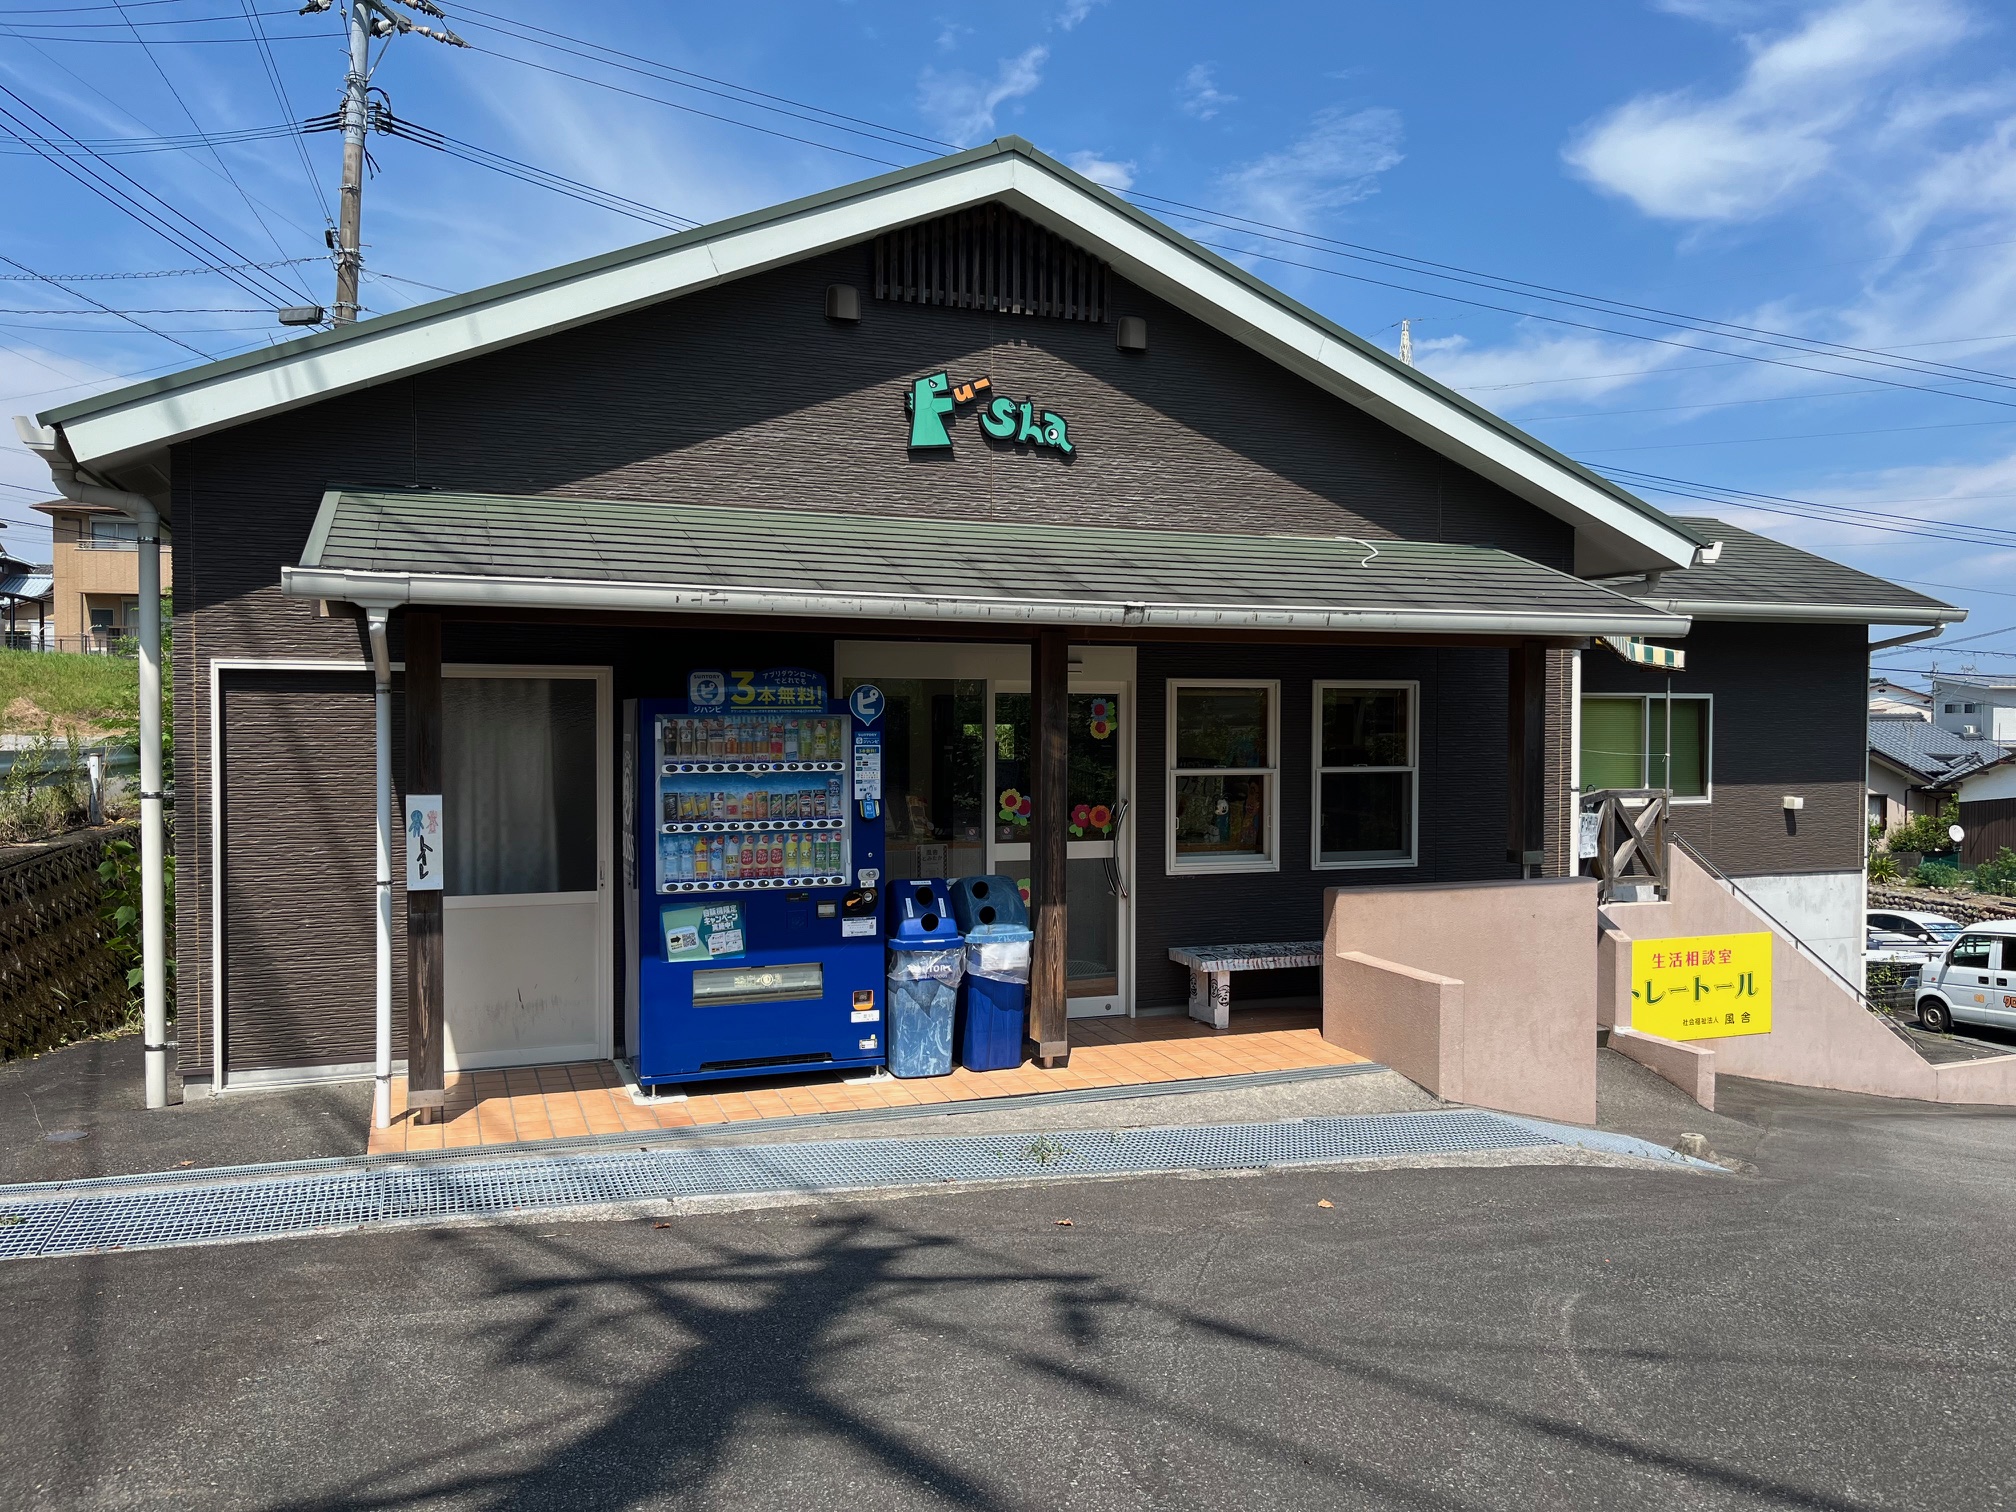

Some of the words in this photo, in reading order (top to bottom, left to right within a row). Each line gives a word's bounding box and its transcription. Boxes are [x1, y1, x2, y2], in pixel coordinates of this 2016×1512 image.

[416, 834, 434, 880] トイレ
[703, 913, 738, 926] キャンペーン
[1651, 948, 1732, 969] 生活相談室
[1632, 970, 1759, 1006] レートール
[1682, 1017, 1719, 1027] 社会福祉法人
[1724, 1011, 1751, 1025] 風舎
